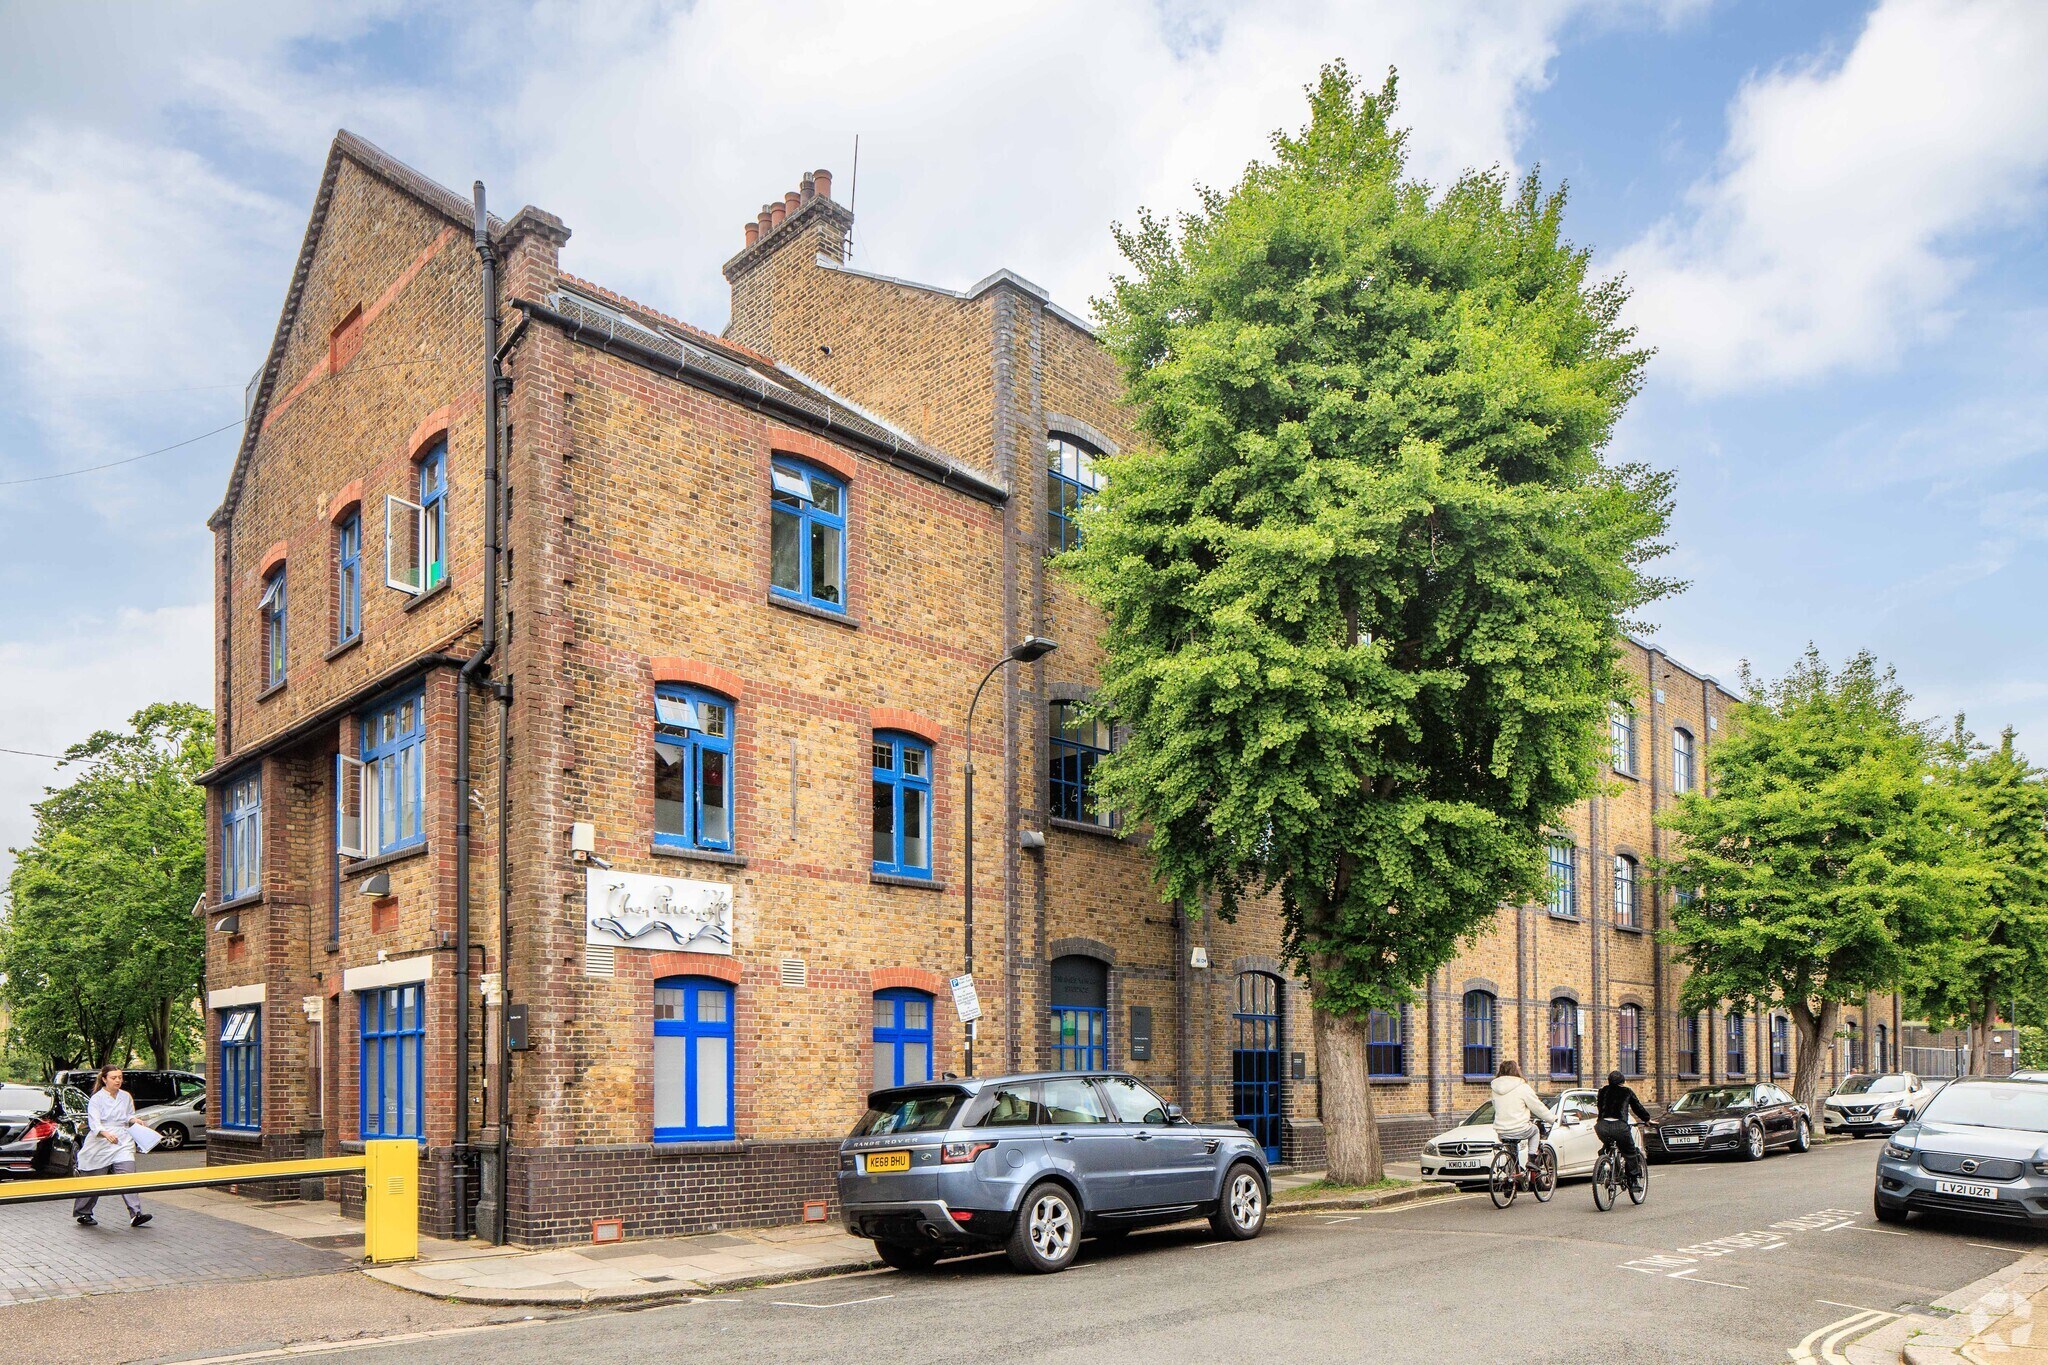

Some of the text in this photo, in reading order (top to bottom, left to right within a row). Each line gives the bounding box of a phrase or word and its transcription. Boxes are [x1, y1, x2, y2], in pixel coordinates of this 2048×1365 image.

[871, 1156, 906, 1167] KE68 BHU
[1942, 1182, 1991, 1197] LV21 UZR
[1677, 1230, 1792, 1257] VEHICLES
[1616, 1254, 1699, 1275] ONLY
